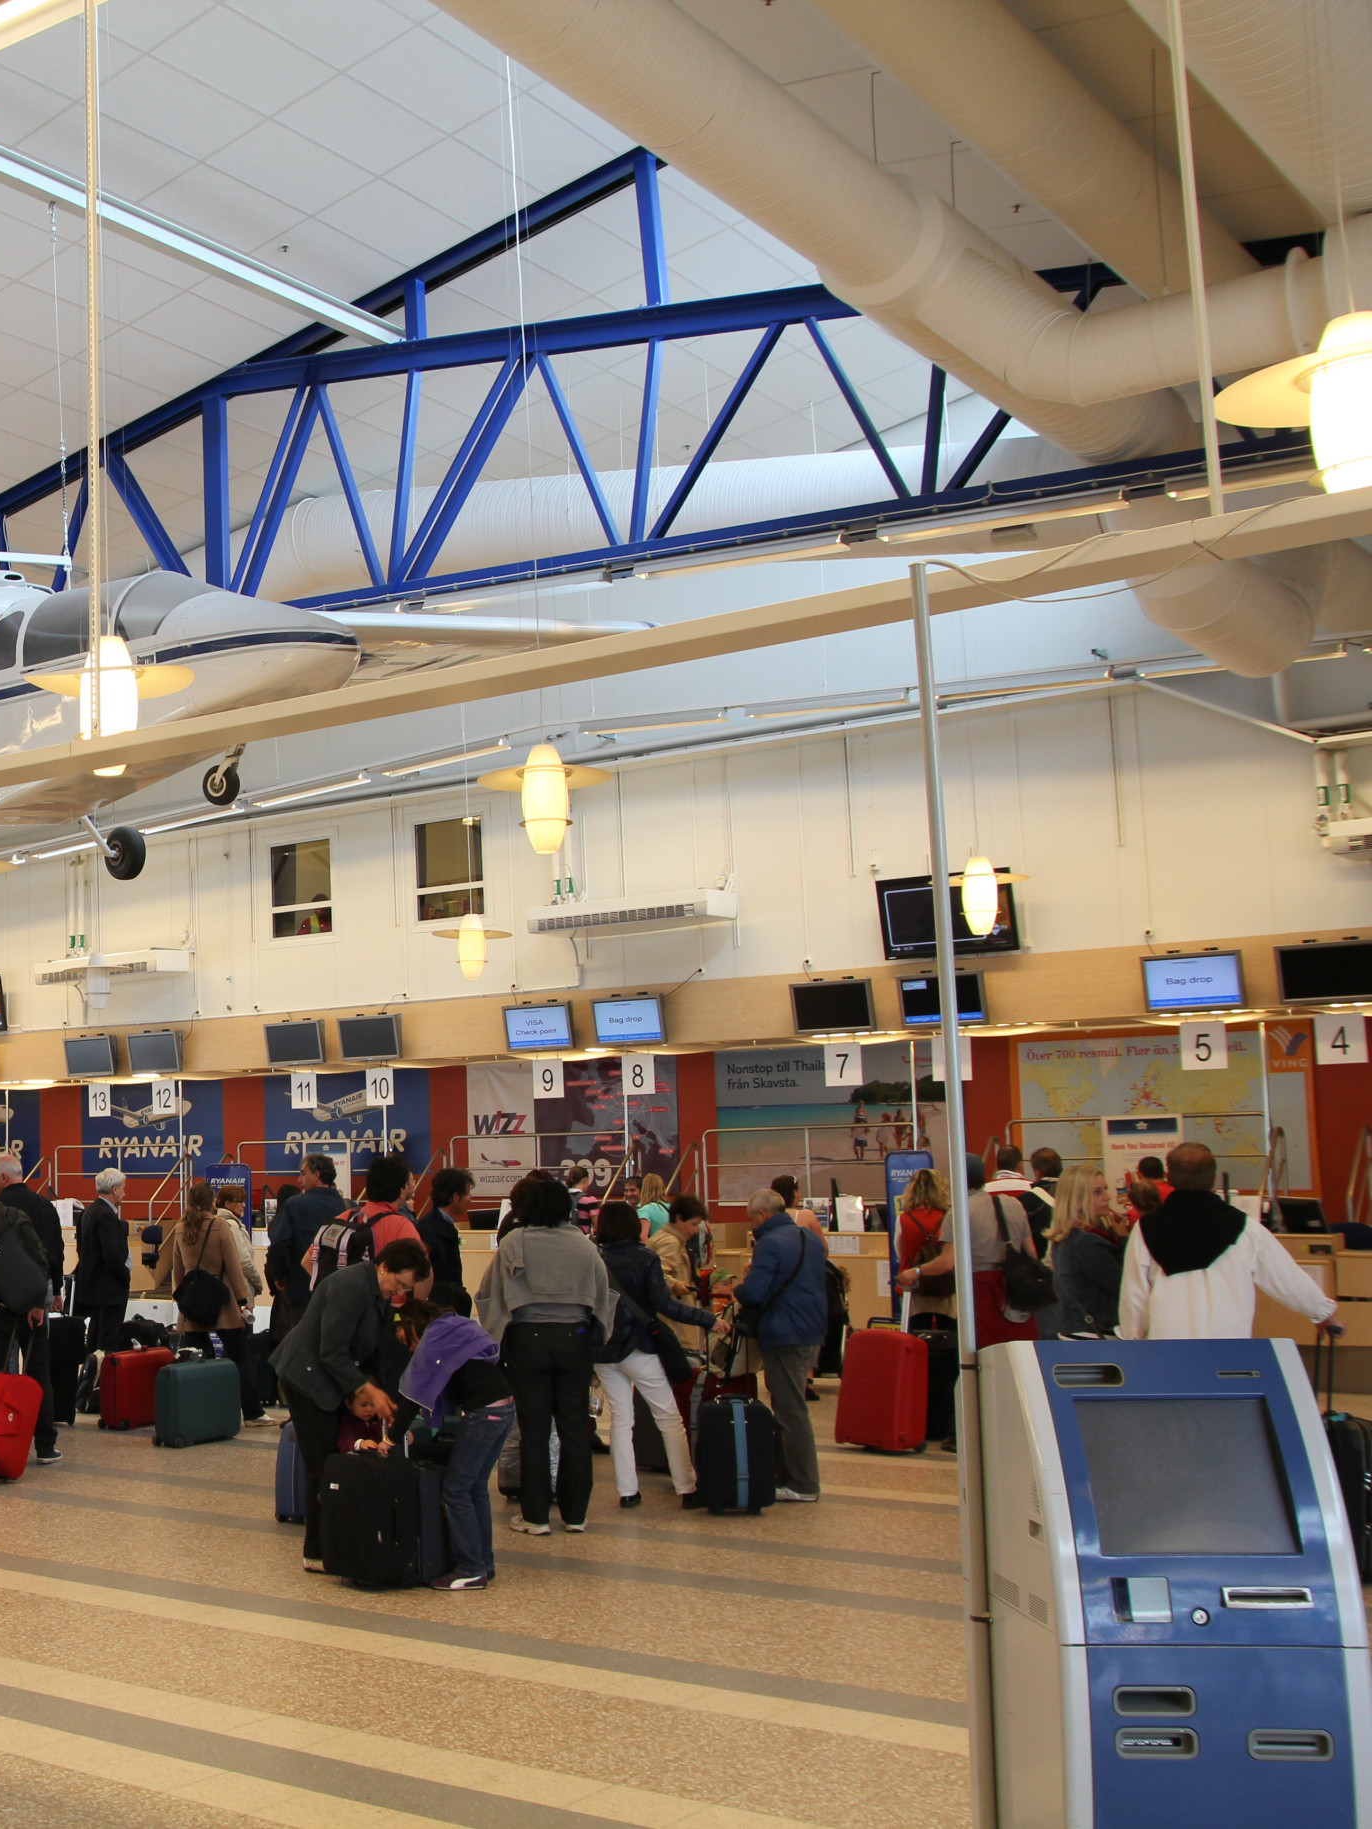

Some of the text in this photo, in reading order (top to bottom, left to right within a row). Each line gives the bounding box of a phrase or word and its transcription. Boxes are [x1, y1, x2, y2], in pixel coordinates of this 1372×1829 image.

[1165, 976, 1213, 986] Bag drop
[525, 1019, 544, 1027] VISA
[608, 1016, 643, 1025] Bag drop
[515, 1027, 557, 1036] Check point
[1331, 1026, 1350, 1055] 4
[1055, 1049, 1076, 1060] 700
[1195, 1033, 1212, 1062] 5
[727, 1063, 773, 1075] Nonstop
[776, 1061, 790, 1072] till
[835, 1053, 849, 1079] 7
[1272, 1058, 1309, 1068] VING
[542, 1068, 553, 1092] 9
[631, 1063, 644, 1088] 8
[727, 1077, 800, 1089] från Skavsta.
[155, 1088, 171, 1109] 12
[297, 1081, 310, 1103] 11
[371, 1077, 389, 1100] 10
[92, 1091, 107, 1112] 13
